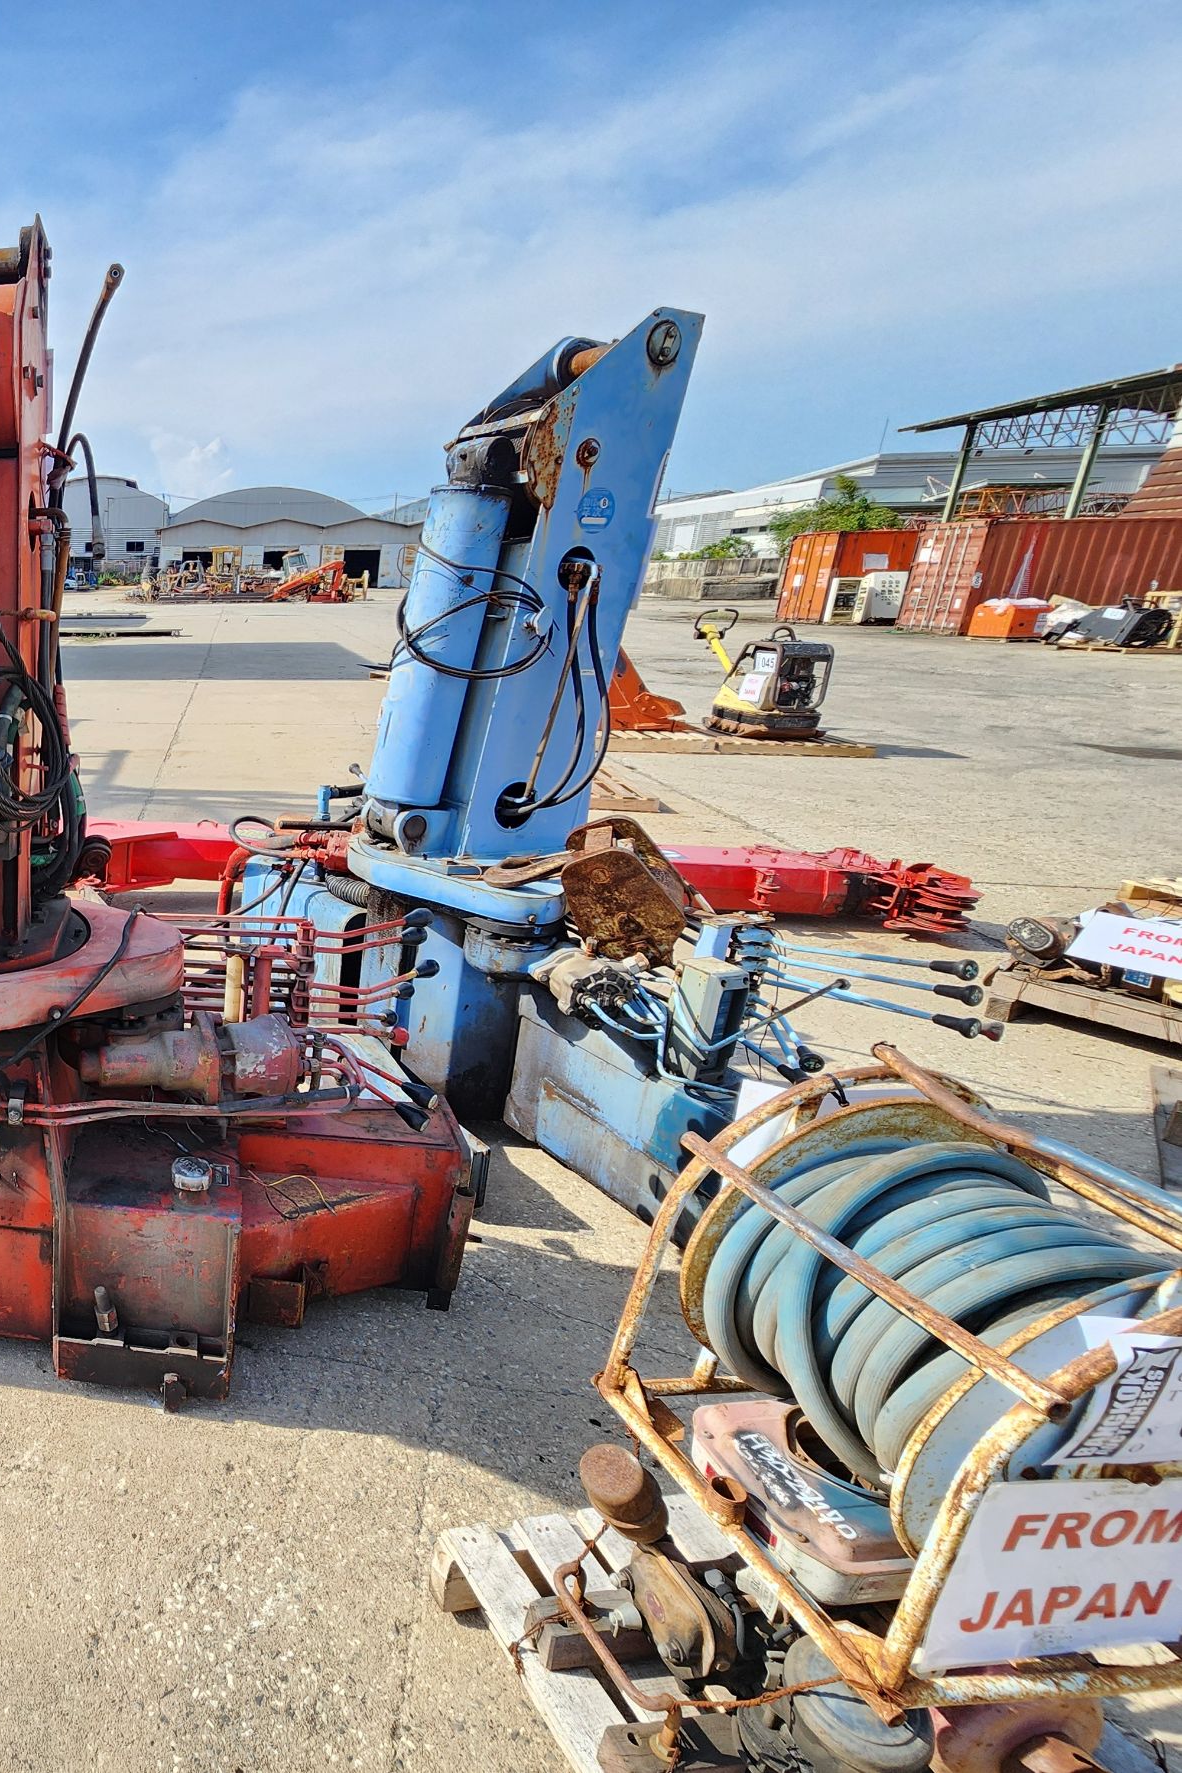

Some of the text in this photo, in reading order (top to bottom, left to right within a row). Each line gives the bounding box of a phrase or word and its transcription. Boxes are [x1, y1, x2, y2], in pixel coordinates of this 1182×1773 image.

[762, 657, 775, 668] 045
[1070, 1367, 1146, 1457] BANGKOK
[1002, 1509, 1182, 1552] FROM
[959, 1579, 1172, 1633] JAPAN
